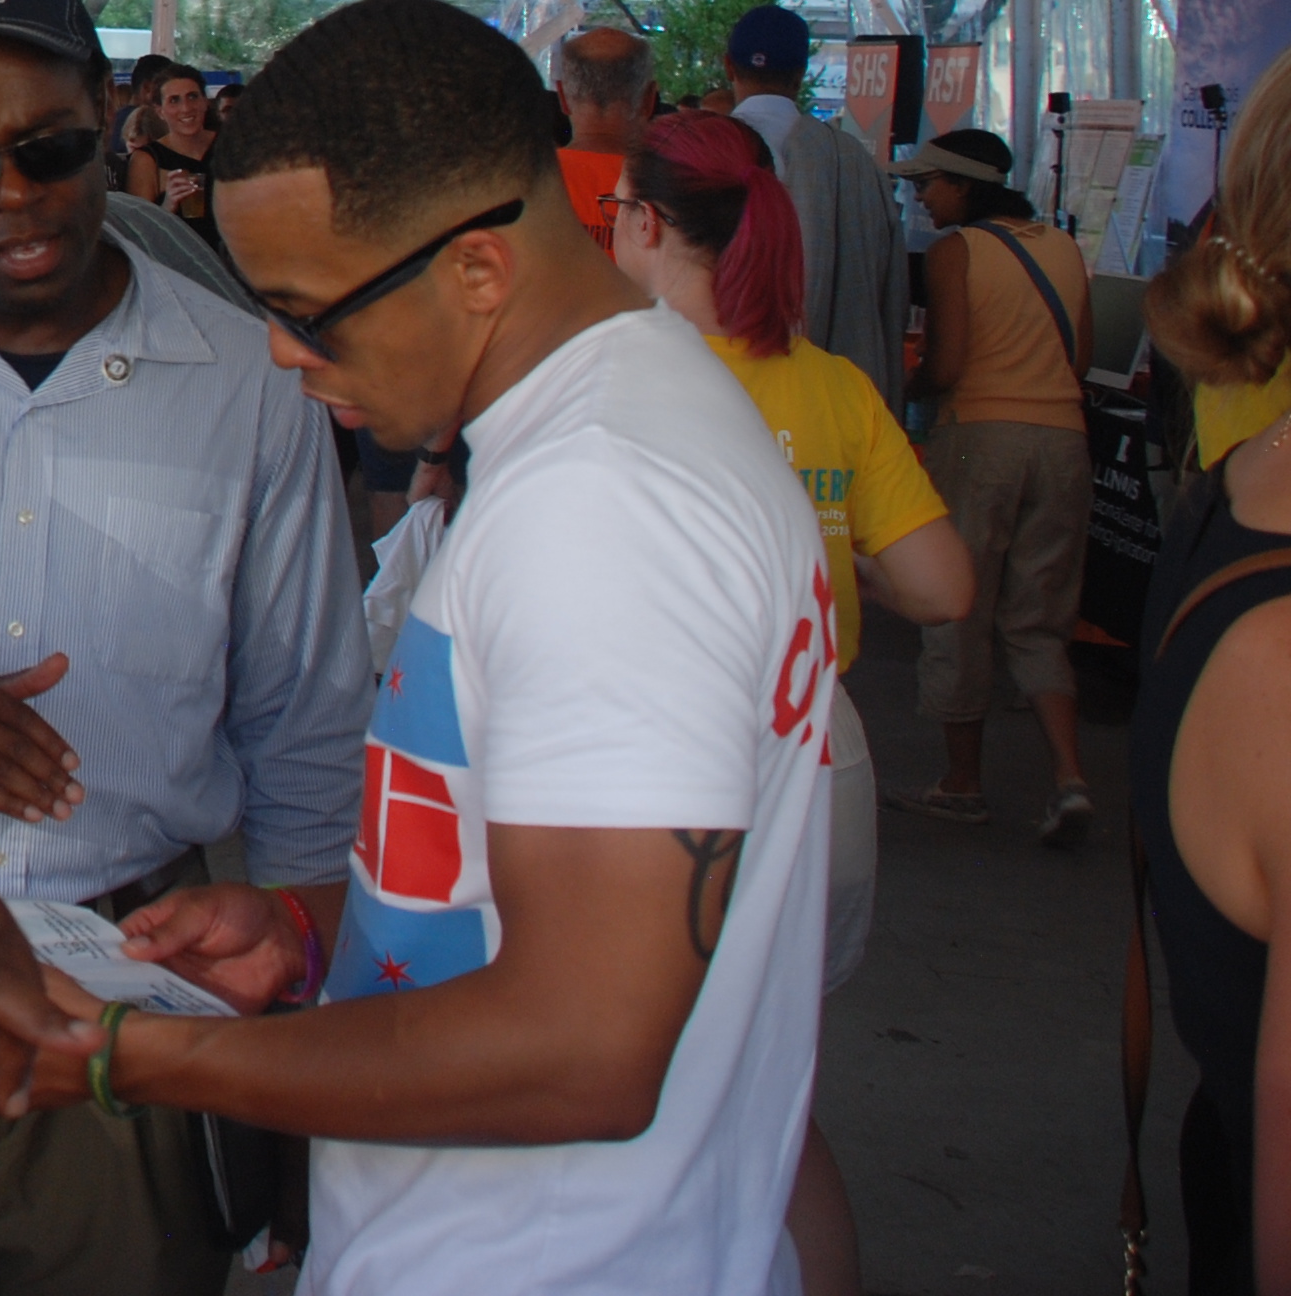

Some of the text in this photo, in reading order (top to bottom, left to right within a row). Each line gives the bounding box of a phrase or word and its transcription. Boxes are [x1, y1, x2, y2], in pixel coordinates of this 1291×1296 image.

[849, 52, 889, 97] SHS
[927, 56, 971, 103] RST
[1181, 109, 1227, 130] COLLEE
